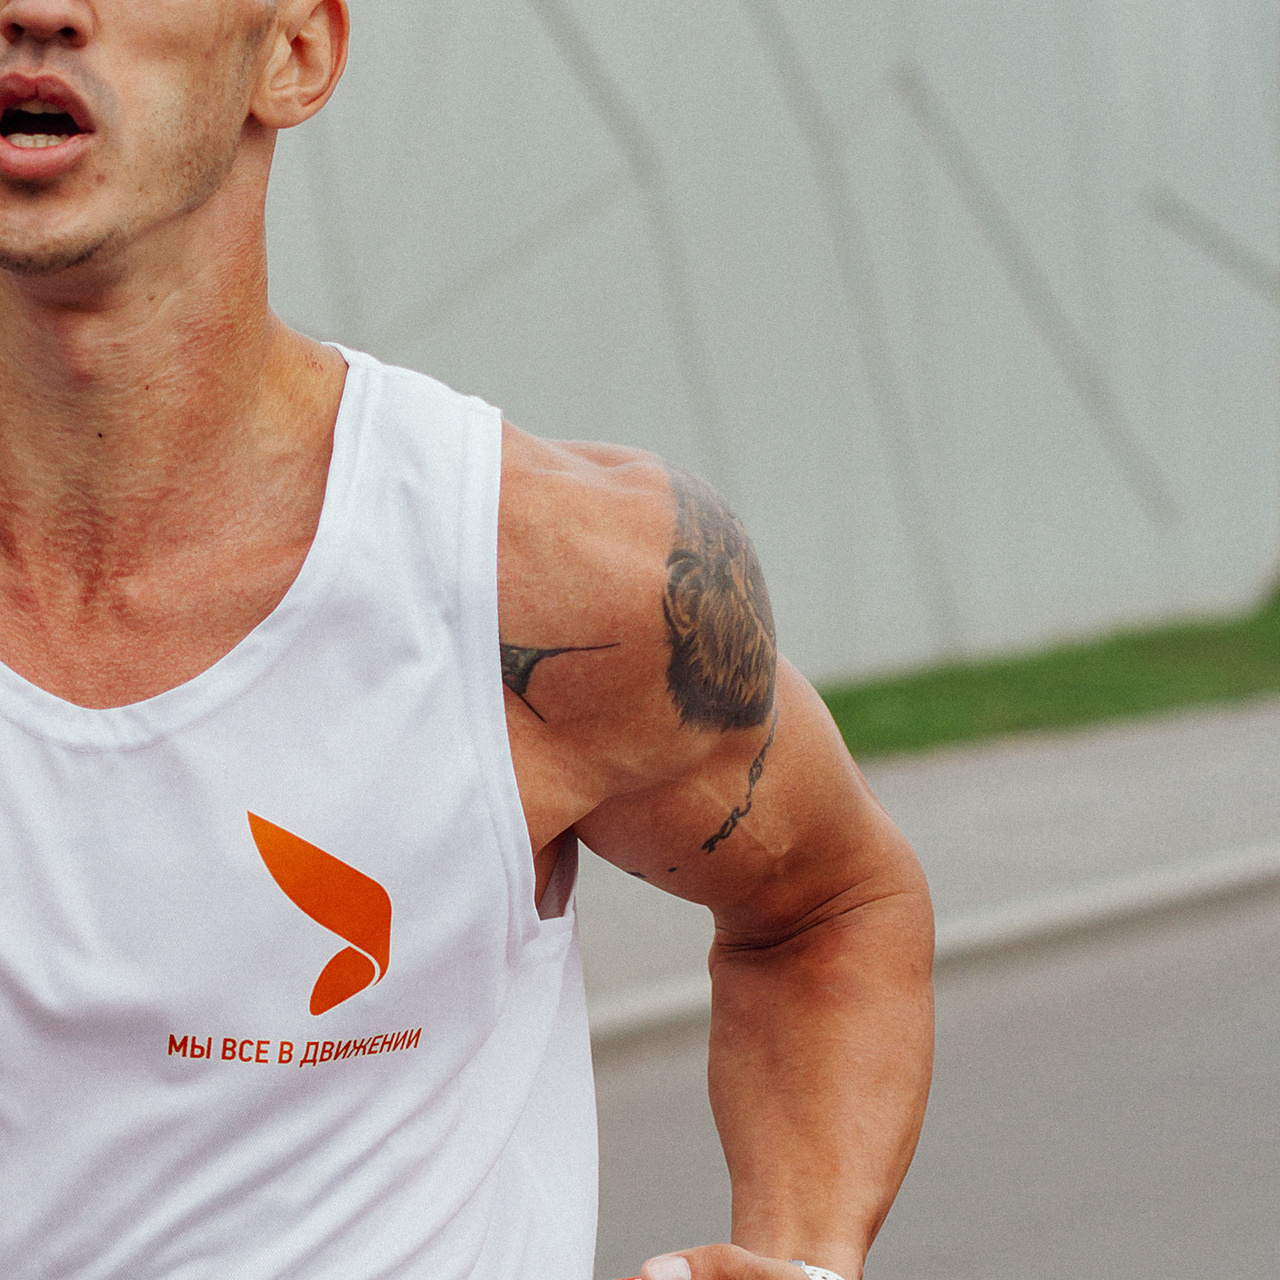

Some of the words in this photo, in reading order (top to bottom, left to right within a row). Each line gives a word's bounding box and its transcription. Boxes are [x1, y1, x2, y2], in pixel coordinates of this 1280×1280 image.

[167, 1033, 212, 1060] МЫ
[221, 1038, 270, 1064] ВСЕ
[277, 1041, 294, 1064] В
[299, 1027, 422, 1068] ДВИЖЕНИИ
